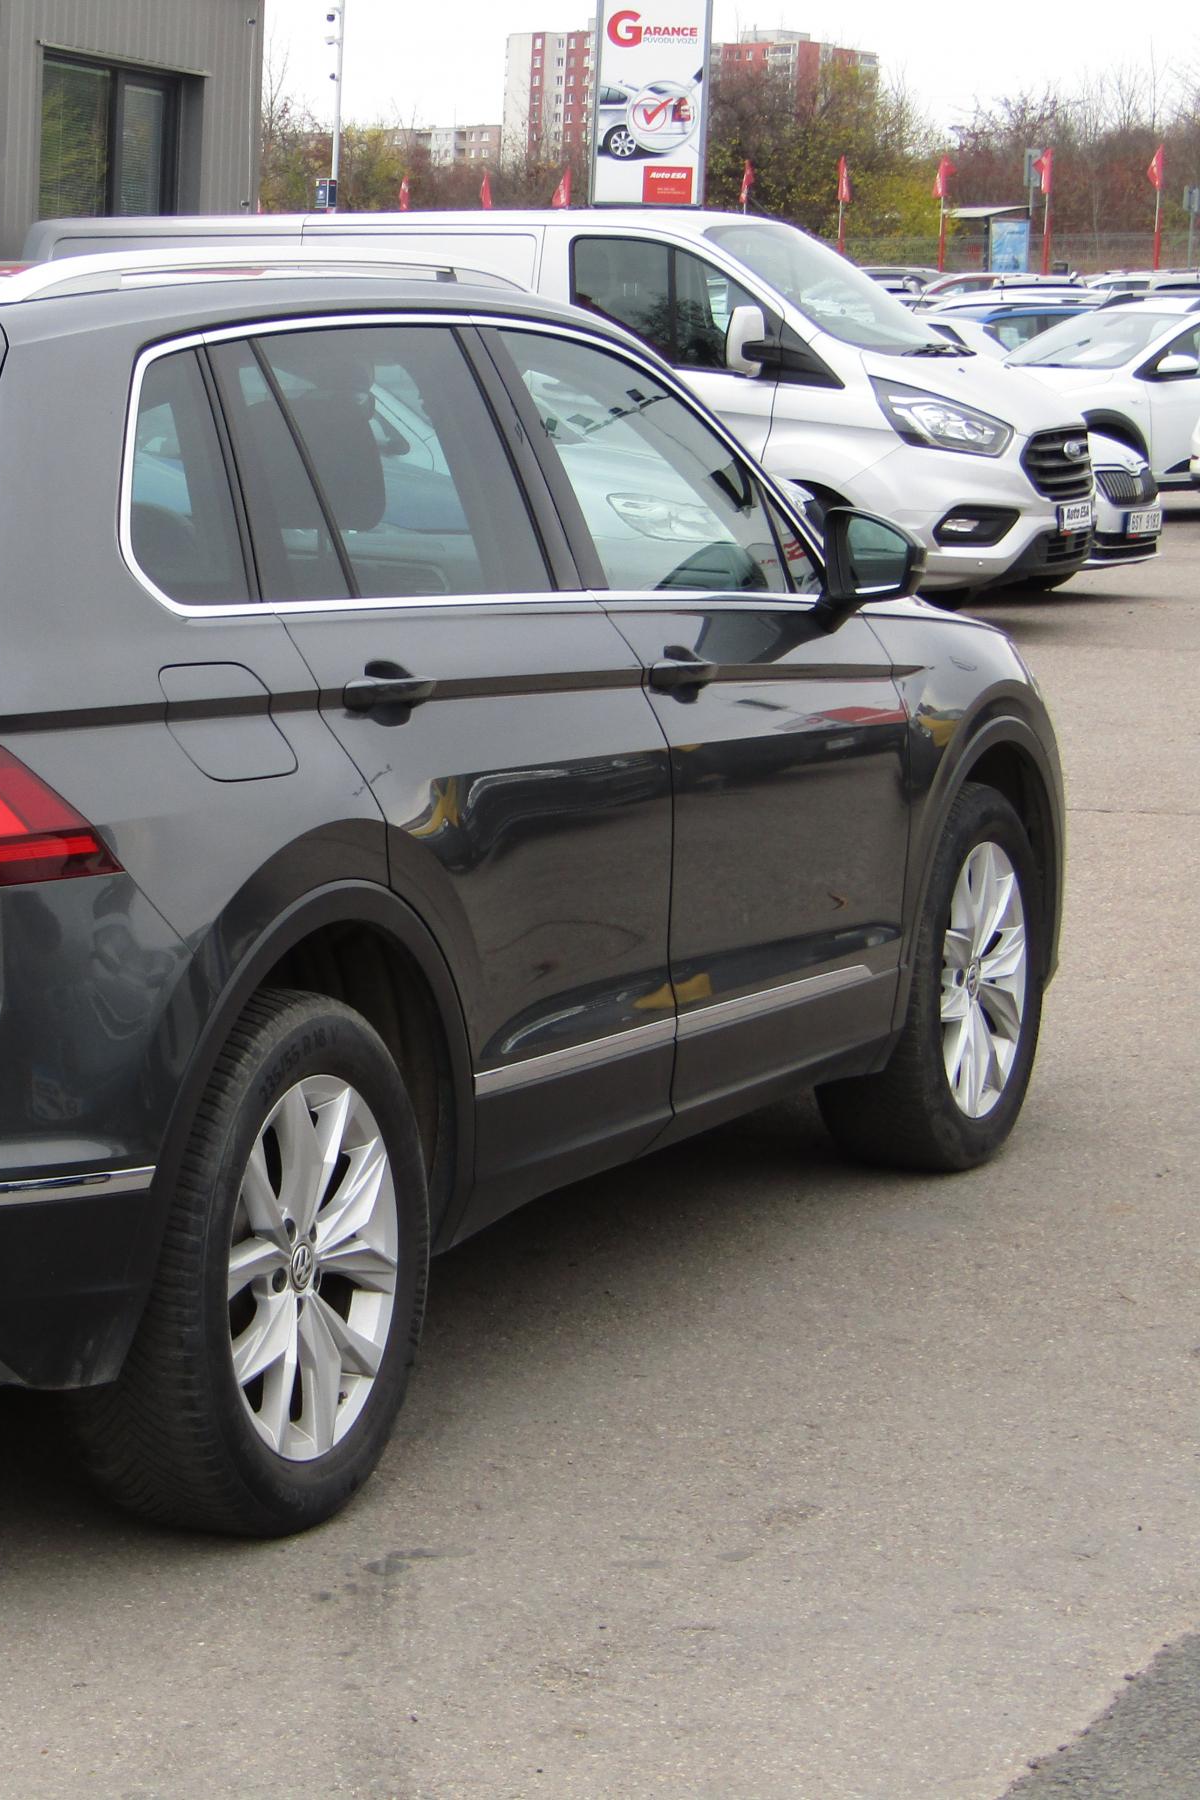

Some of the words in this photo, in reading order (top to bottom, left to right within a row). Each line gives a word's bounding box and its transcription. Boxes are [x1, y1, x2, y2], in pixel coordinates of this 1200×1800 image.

[607, 10, 698, 47] GARANCE
[650, 171, 670, 179] Auto
[1066, 507, 1080, 520] Auto
